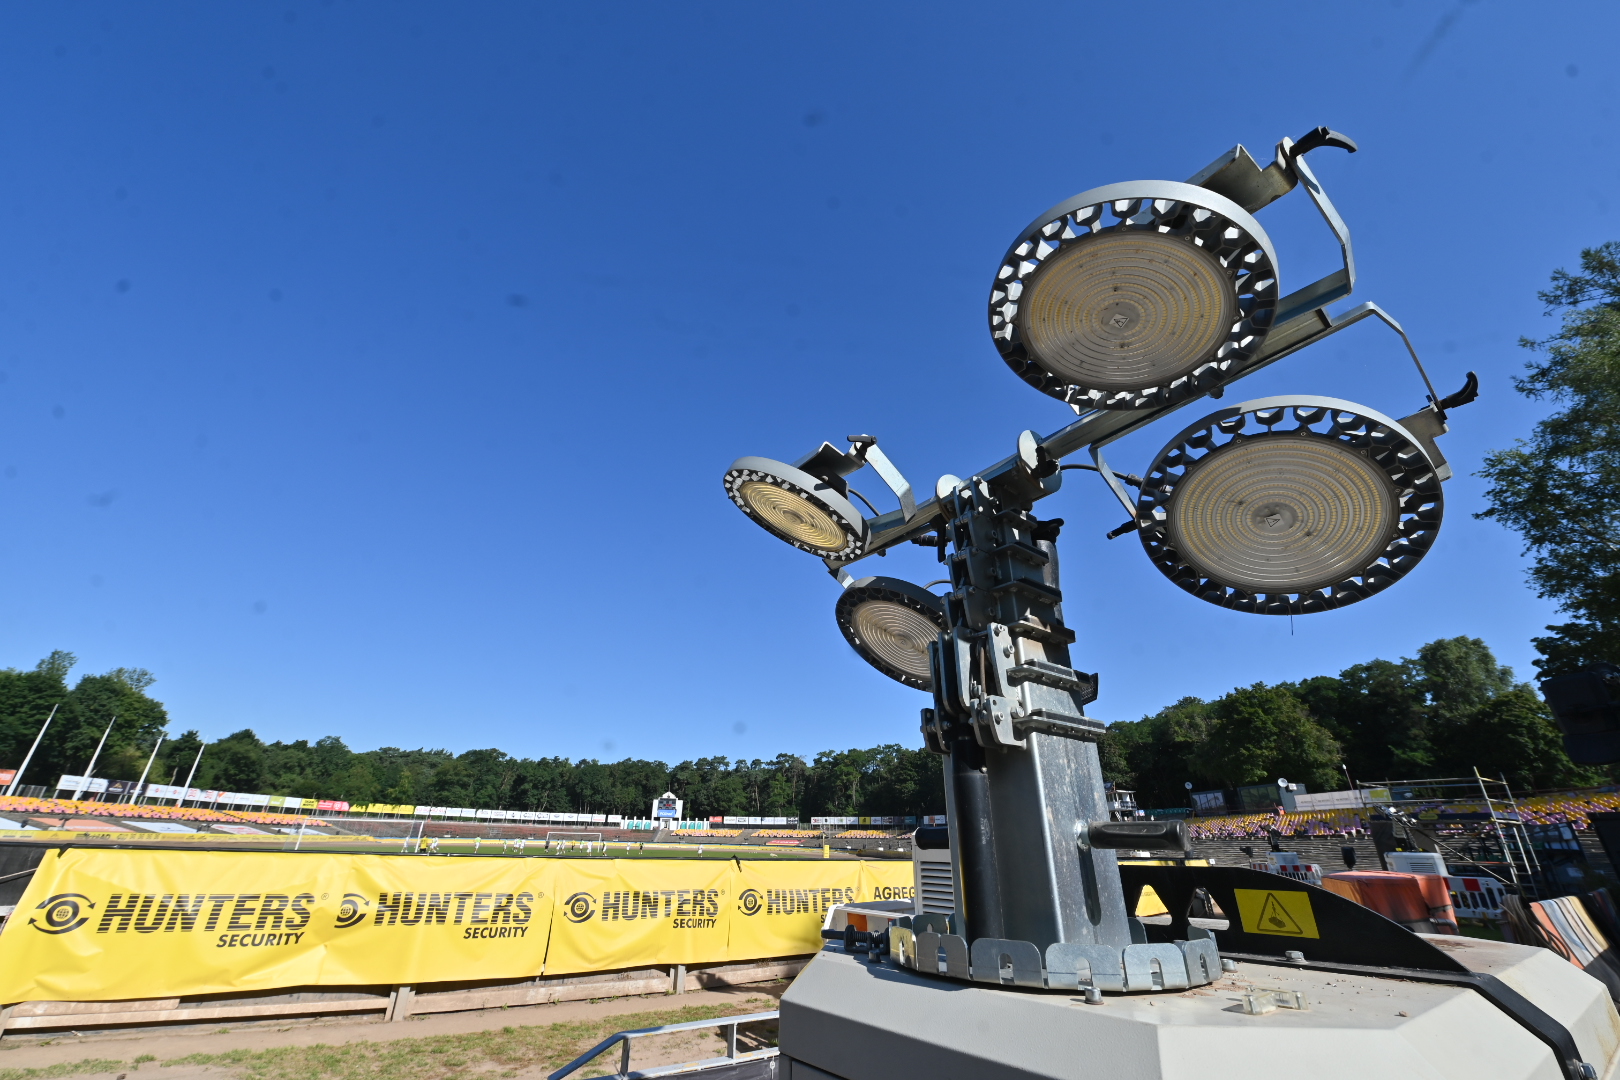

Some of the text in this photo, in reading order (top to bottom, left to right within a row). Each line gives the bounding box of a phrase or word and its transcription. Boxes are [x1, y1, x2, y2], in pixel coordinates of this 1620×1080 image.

[96, 893, 315, 933] HUNTERS
[374, 891, 534, 926] HUNTERS
[601, 889, 719, 921] HUNTERS
[463, 926, 528, 939] SECURITY
[672, 918, 717, 929] SECURITY
[216, 931, 305, 948] SECURITY
